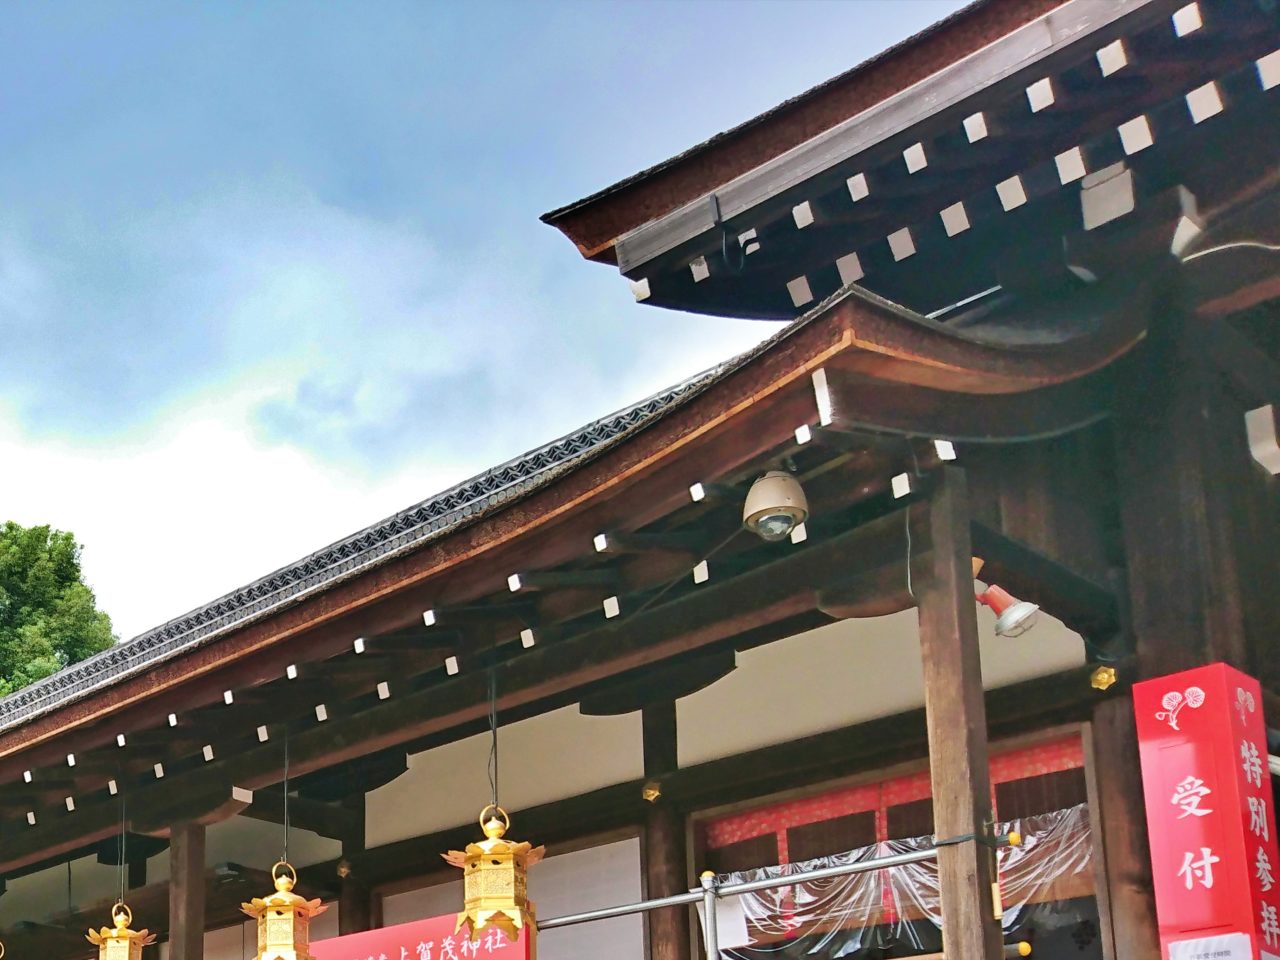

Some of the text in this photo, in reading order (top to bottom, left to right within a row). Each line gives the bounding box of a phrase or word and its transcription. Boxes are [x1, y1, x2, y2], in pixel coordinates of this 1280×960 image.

[1169, 775, 1221, 891] 受付
[1240, 739, 1280, 949] 特別参拝
